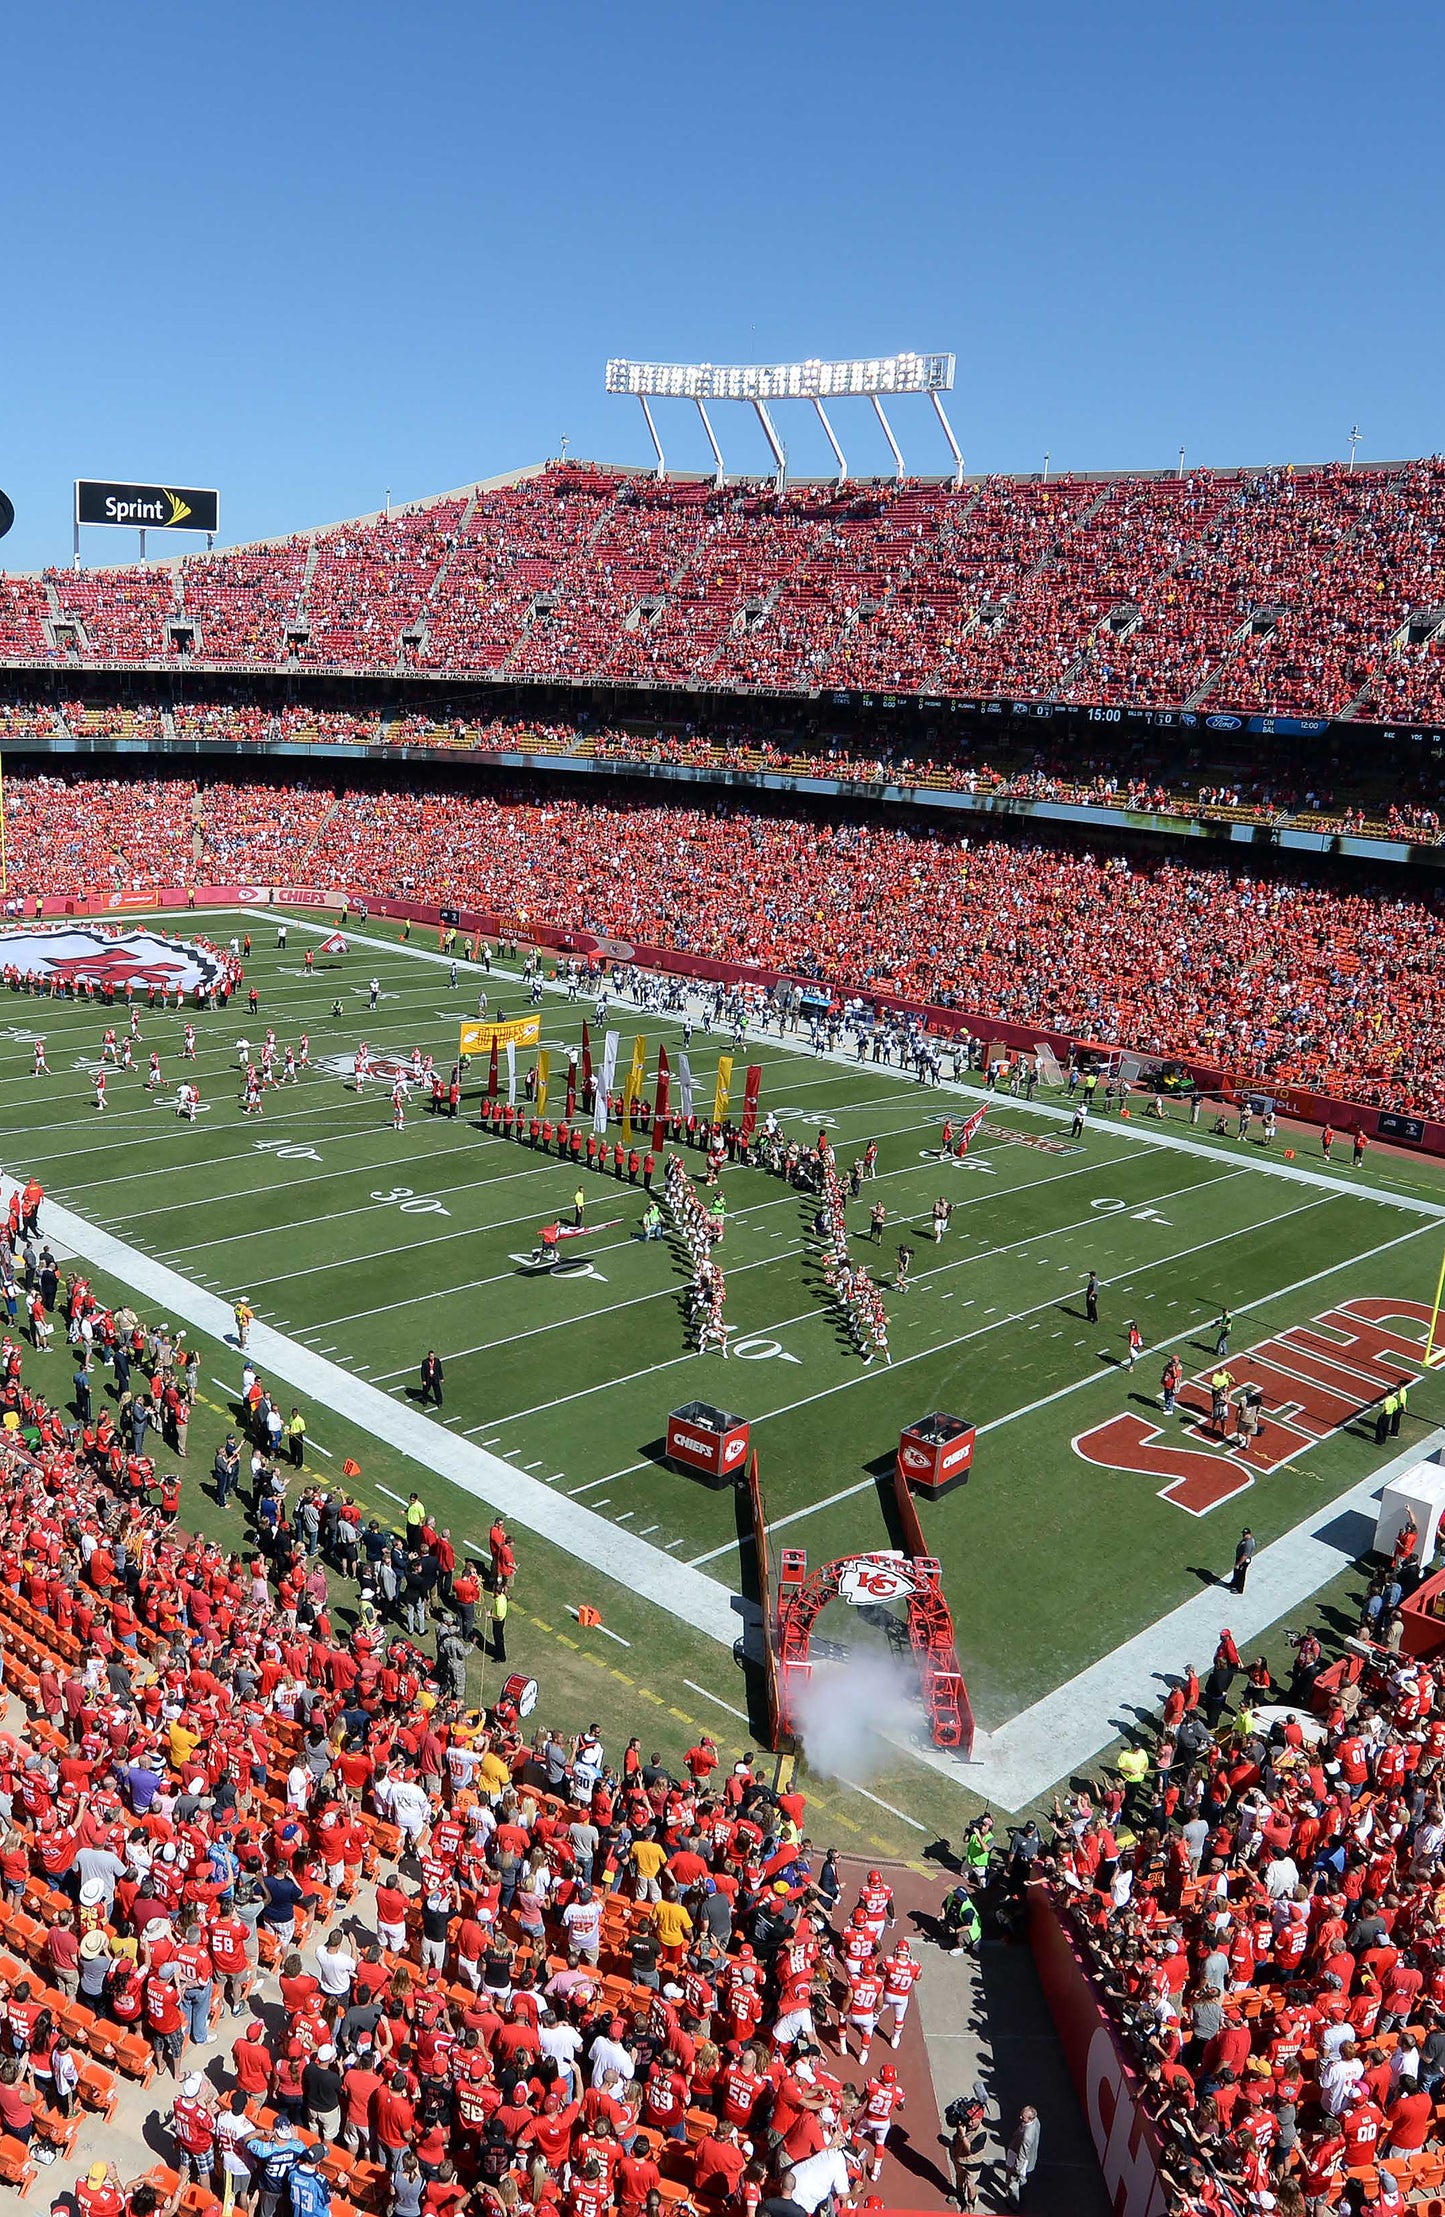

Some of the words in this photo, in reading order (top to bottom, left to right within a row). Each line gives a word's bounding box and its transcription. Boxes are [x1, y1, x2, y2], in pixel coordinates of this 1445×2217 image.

[105, 496, 163, 522] Sprint
[1036, 706, 1043, 715] 0
[1088, 708, 1121, 722] 15:00
[1164, 714, 1172, 724] 0
[1212, 716, 1236, 730] Ford
[1300, 721, 1318, 730] 12:00
[278, 890, 326, 904] CHIEFS
[520, 923, 530, 932] TO
[1274, 1087, 1290, 1099] TO
[252, 1140, 316, 1158] 40
[370, 1188, 442, 1213] 30
[1090, 1198, 1166, 1220] 10
[673, 1433, 714, 1458] CHIEFS
[942, 1444, 971, 1469] CHIEFS
[857, 1572, 898, 1596] KC
[284, 1694, 298, 1704] 88
[576, 1776, 590, 1789] 30
[440, 1836, 458, 1853] 58
[866, 1900, 888, 1914] 97
[572, 1922, 594, 1934] 22
[212, 1936, 234, 1954] 58
[850, 1940, 872, 1956] 92
[1258, 1933, 1272, 1950] 25
[1290, 1936, 1307, 1954] 25
[890, 1972, 913, 1990] 70
[854, 1990, 878, 2008] 90
[728, 2084, 751, 2109] 58
[868, 2094, 892, 2117] 21
[1357, 2122, 1377, 2143] 00
[290, 2185, 314, 2212] 13
